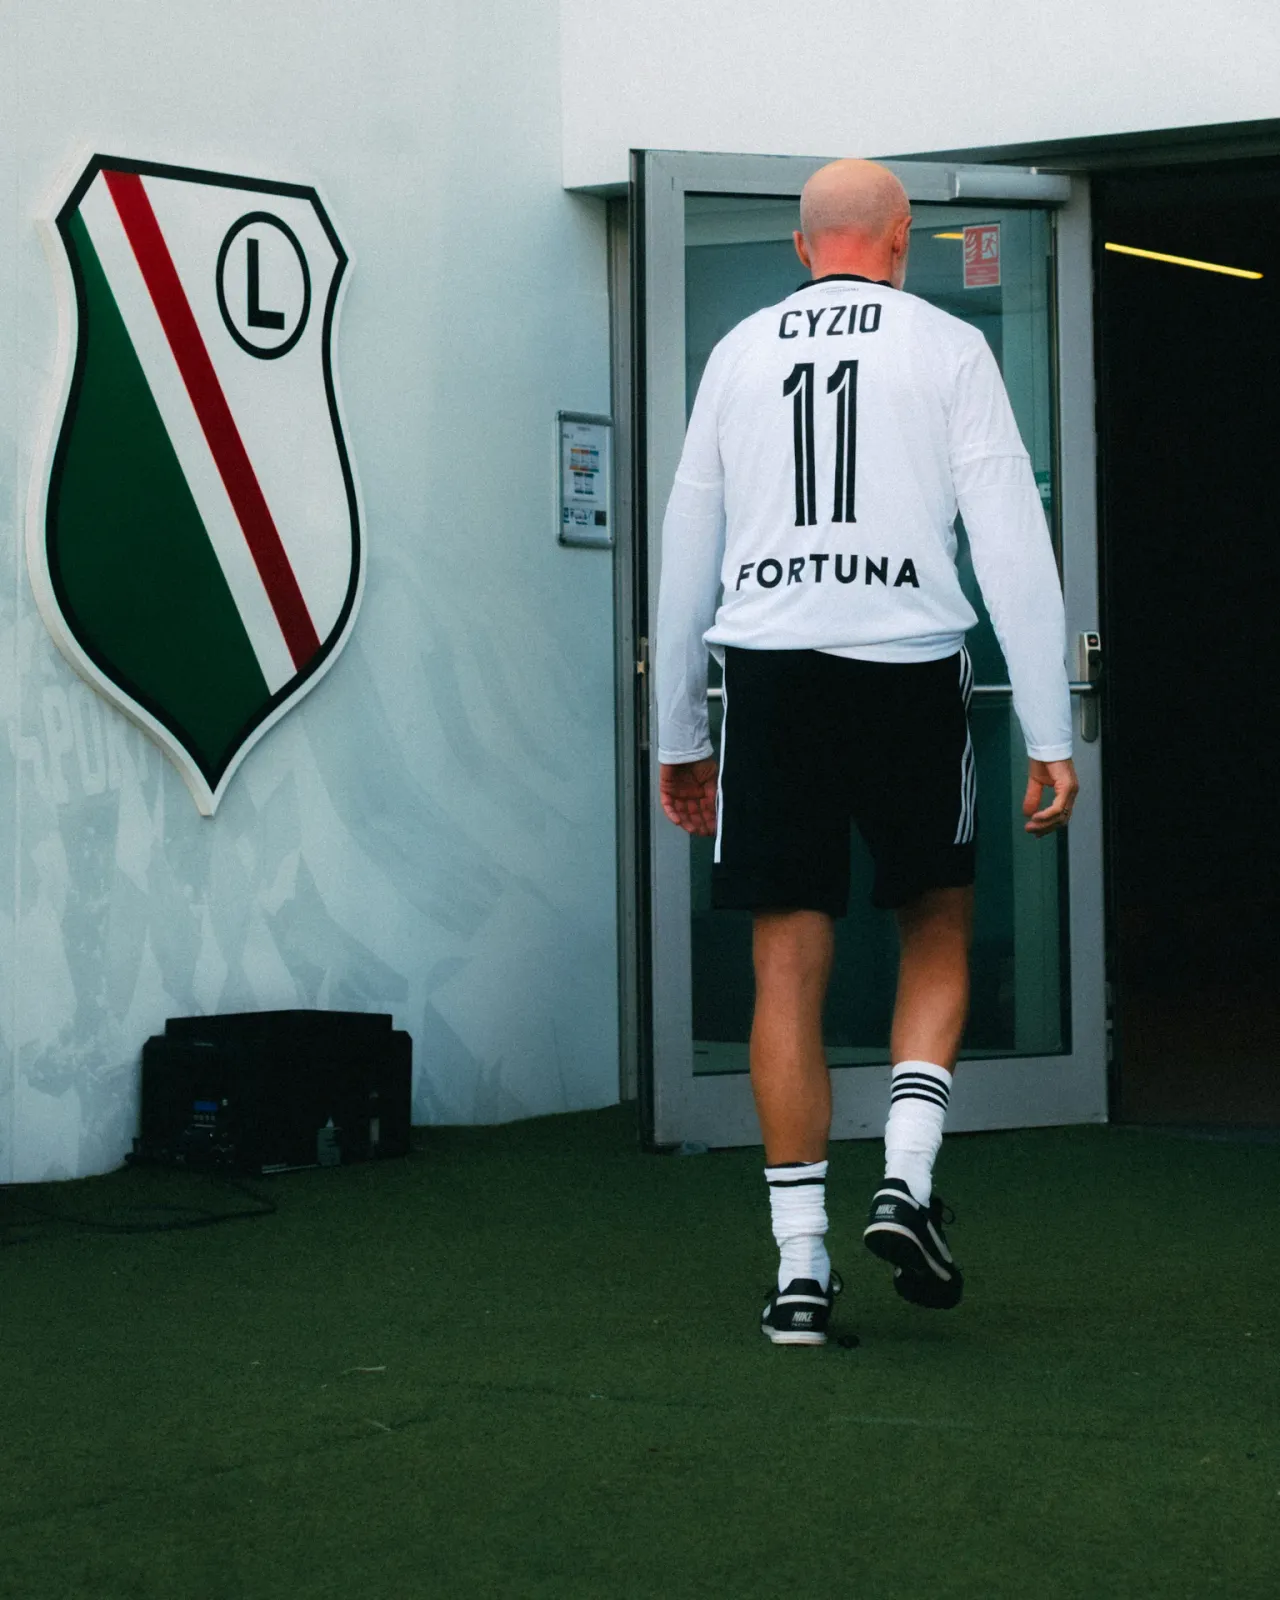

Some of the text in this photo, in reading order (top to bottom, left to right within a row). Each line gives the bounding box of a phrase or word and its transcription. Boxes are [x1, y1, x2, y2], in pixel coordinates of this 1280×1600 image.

[246, 238, 285, 330] L
[779, 303, 882, 339] CYZIO
[783, 359, 859, 526] 11
[736, 553, 920, 590] FORTUNA
[875, 1203, 897, 1215] NIKE
[792, 1311, 814, 1322] NIKE
